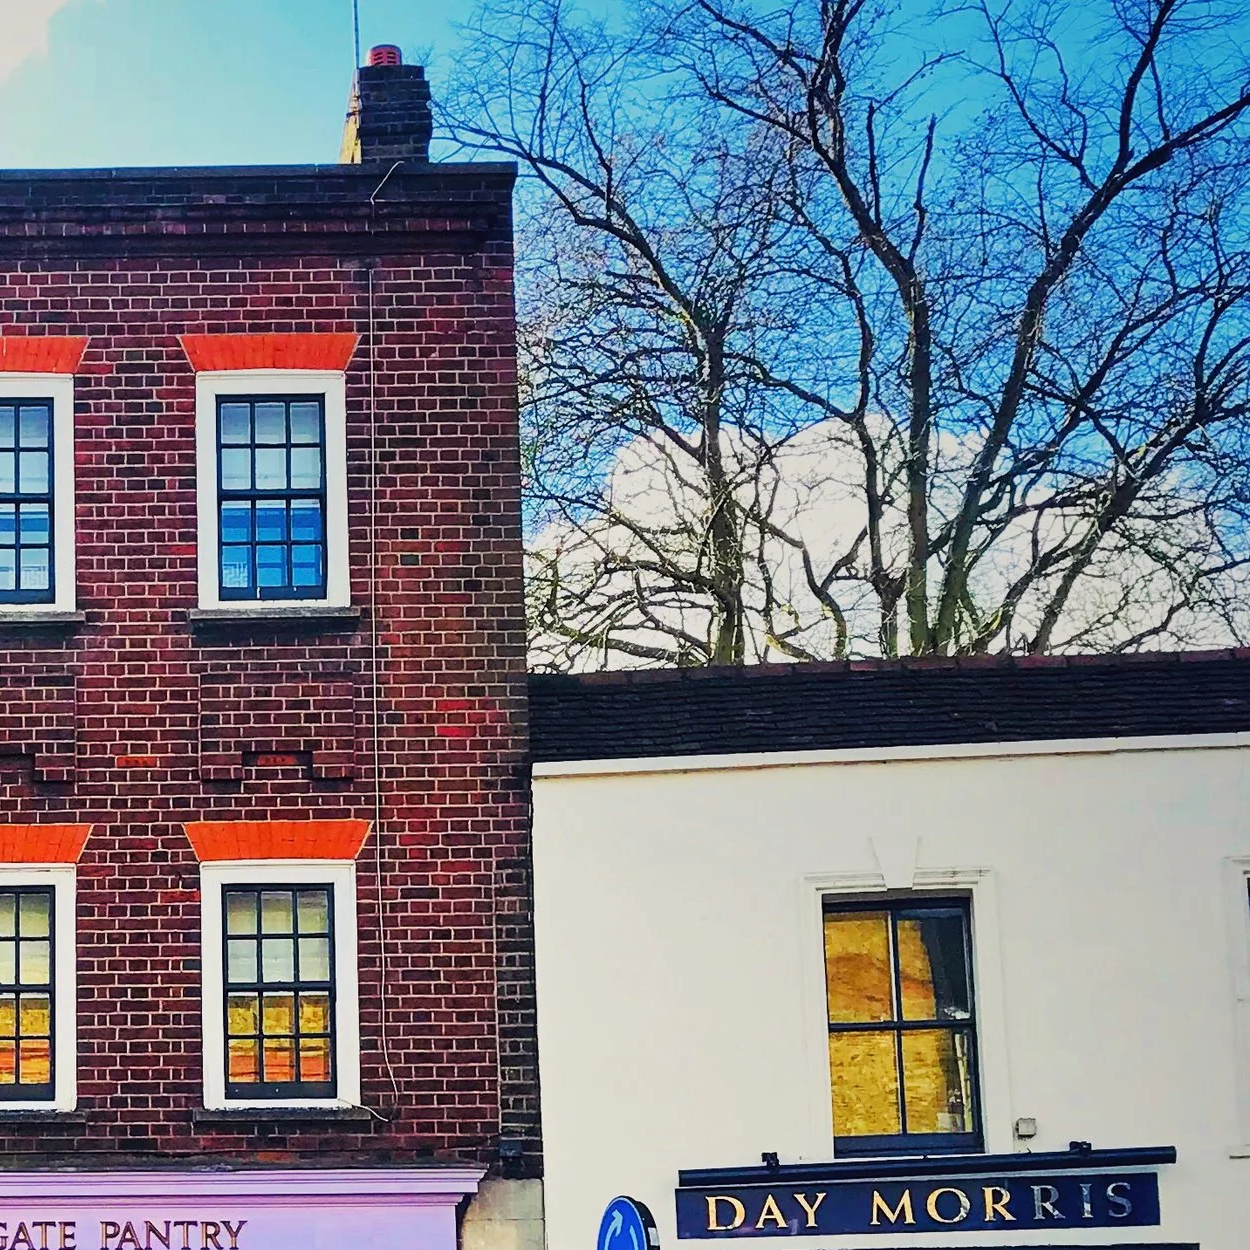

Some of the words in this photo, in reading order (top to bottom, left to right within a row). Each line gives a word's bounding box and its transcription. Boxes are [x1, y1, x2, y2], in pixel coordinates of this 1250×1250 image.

[705, 1192, 827, 1231] DAY
[869, 1182, 1134, 1227] MORRIS
[99, 1220, 248, 1250] PANTRY
